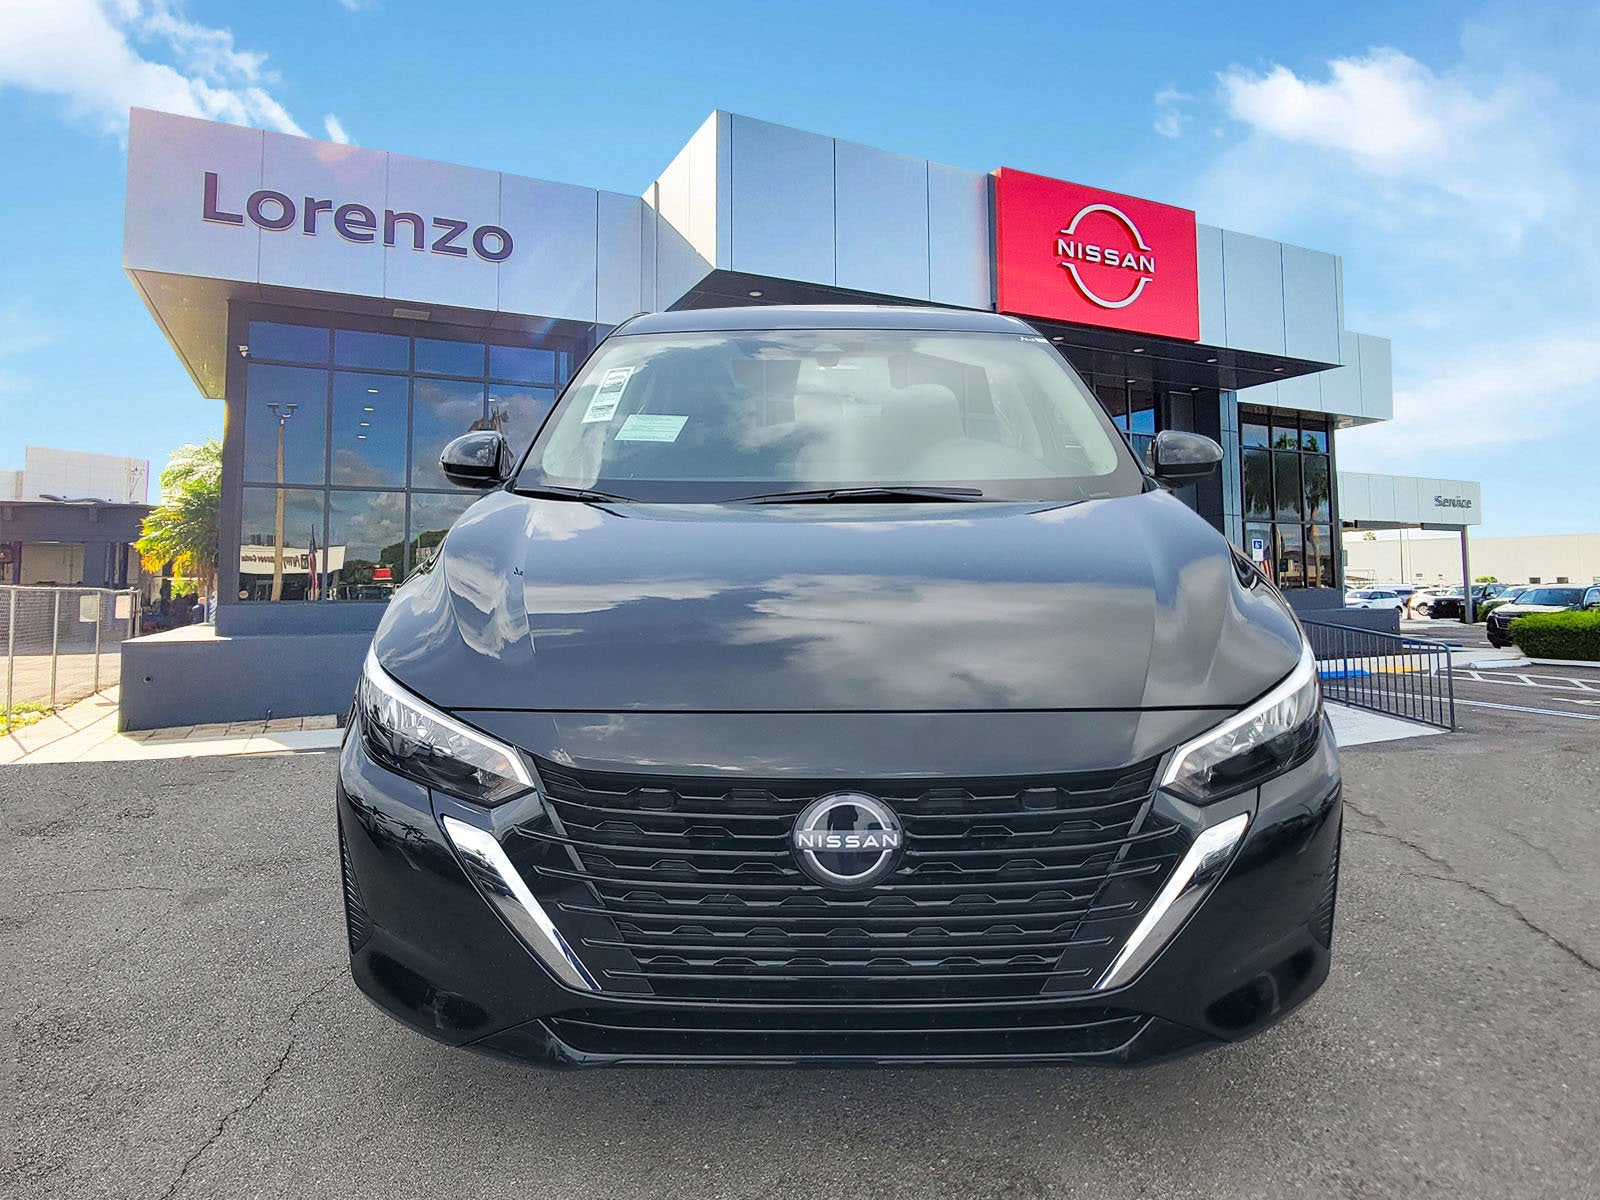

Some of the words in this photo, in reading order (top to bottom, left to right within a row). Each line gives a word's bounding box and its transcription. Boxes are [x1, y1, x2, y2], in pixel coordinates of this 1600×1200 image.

[203, 171, 514, 263] Lorenzo
[1057, 238, 1155, 273] NISSAN
[1434, 495, 1472, 508] Service
[798, 833, 898, 848] NISSAN
